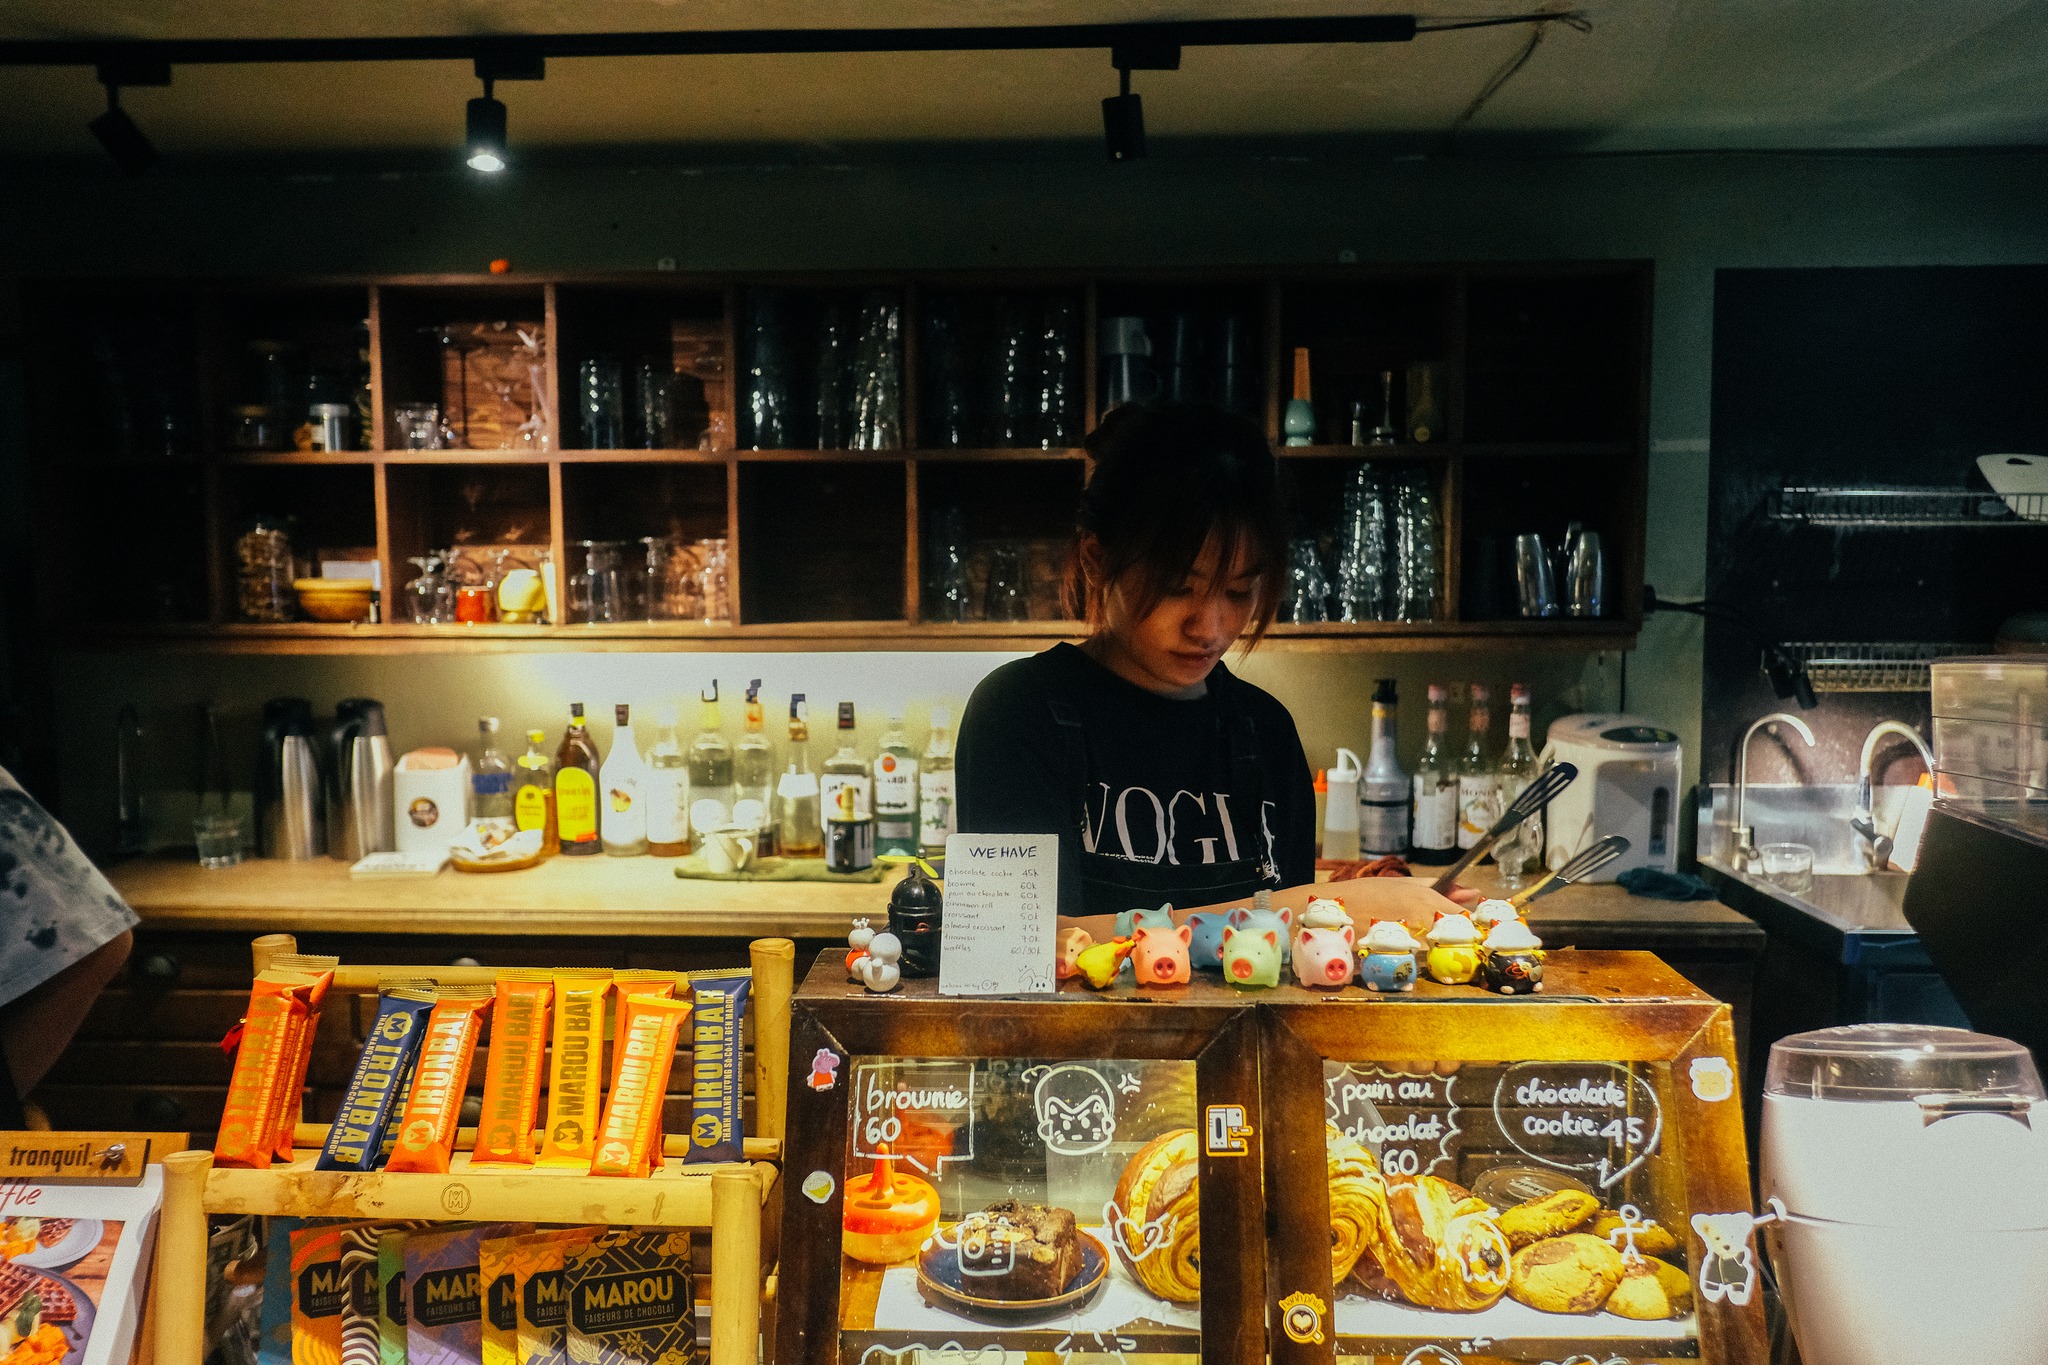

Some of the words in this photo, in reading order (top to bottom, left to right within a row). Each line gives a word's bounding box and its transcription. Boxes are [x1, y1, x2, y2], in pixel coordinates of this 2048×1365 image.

[969, 847, 997, 858] WE
[1001, 846, 1037, 858] HAVE
[947, 878, 976, 888] brownie
[1020, 881, 1037, 890] 60k
[949, 868, 986, 877] chocolate
[991, 869, 1013, 877] cookie
[1022, 869, 1039, 877] 45k
[1020, 891, 1038, 899] 60k
[944, 943, 971, 952] waffles
[503, 994, 535, 1035] BAR
[564, 990, 593, 1031] BAR
[725, 995, 734, 1019] MAROU
[625, 1014, 663, 1056] BAR
[693, 991, 725, 1108] IRONBAR
[227, 997, 282, 1115] IRONBAR
[411, 1009, 468, 1113] IRONBAR
[492, 1041, 528, 1119] MAROU
[557, 1037, 589, 1115] MAROU
[333, 1046, 403, 1161] IRONBAR
[605, 1059, 652, 1139] MAROU
[867, 1072, 967, 1112] brownie
[1341, 1080, 1394, 1105] pain
[1399, 1080, 1435, 1100] au
[1517, 1078, 1626, 1108] chocolate
[327, 1130, 344, 1154] MAROU
[865, 1115, 901, 1145] 60
[1344, 1114, 1443, 1144] chocolat
[1523, 1111, 1598, 1137] cookie
[1600, 1117, 1645, 1148] 45
[9, 1142, 93, 1172] tranquil.
[1383, 1149, 1419, 1176] 60
[584, 1275, 674, 1311] MAROU
[584, 1306, 622, 1324] FAISEURS
[624, 1308, 633, 1319] DE
[637, 1303, 675, 1317] CHOCOLAT
